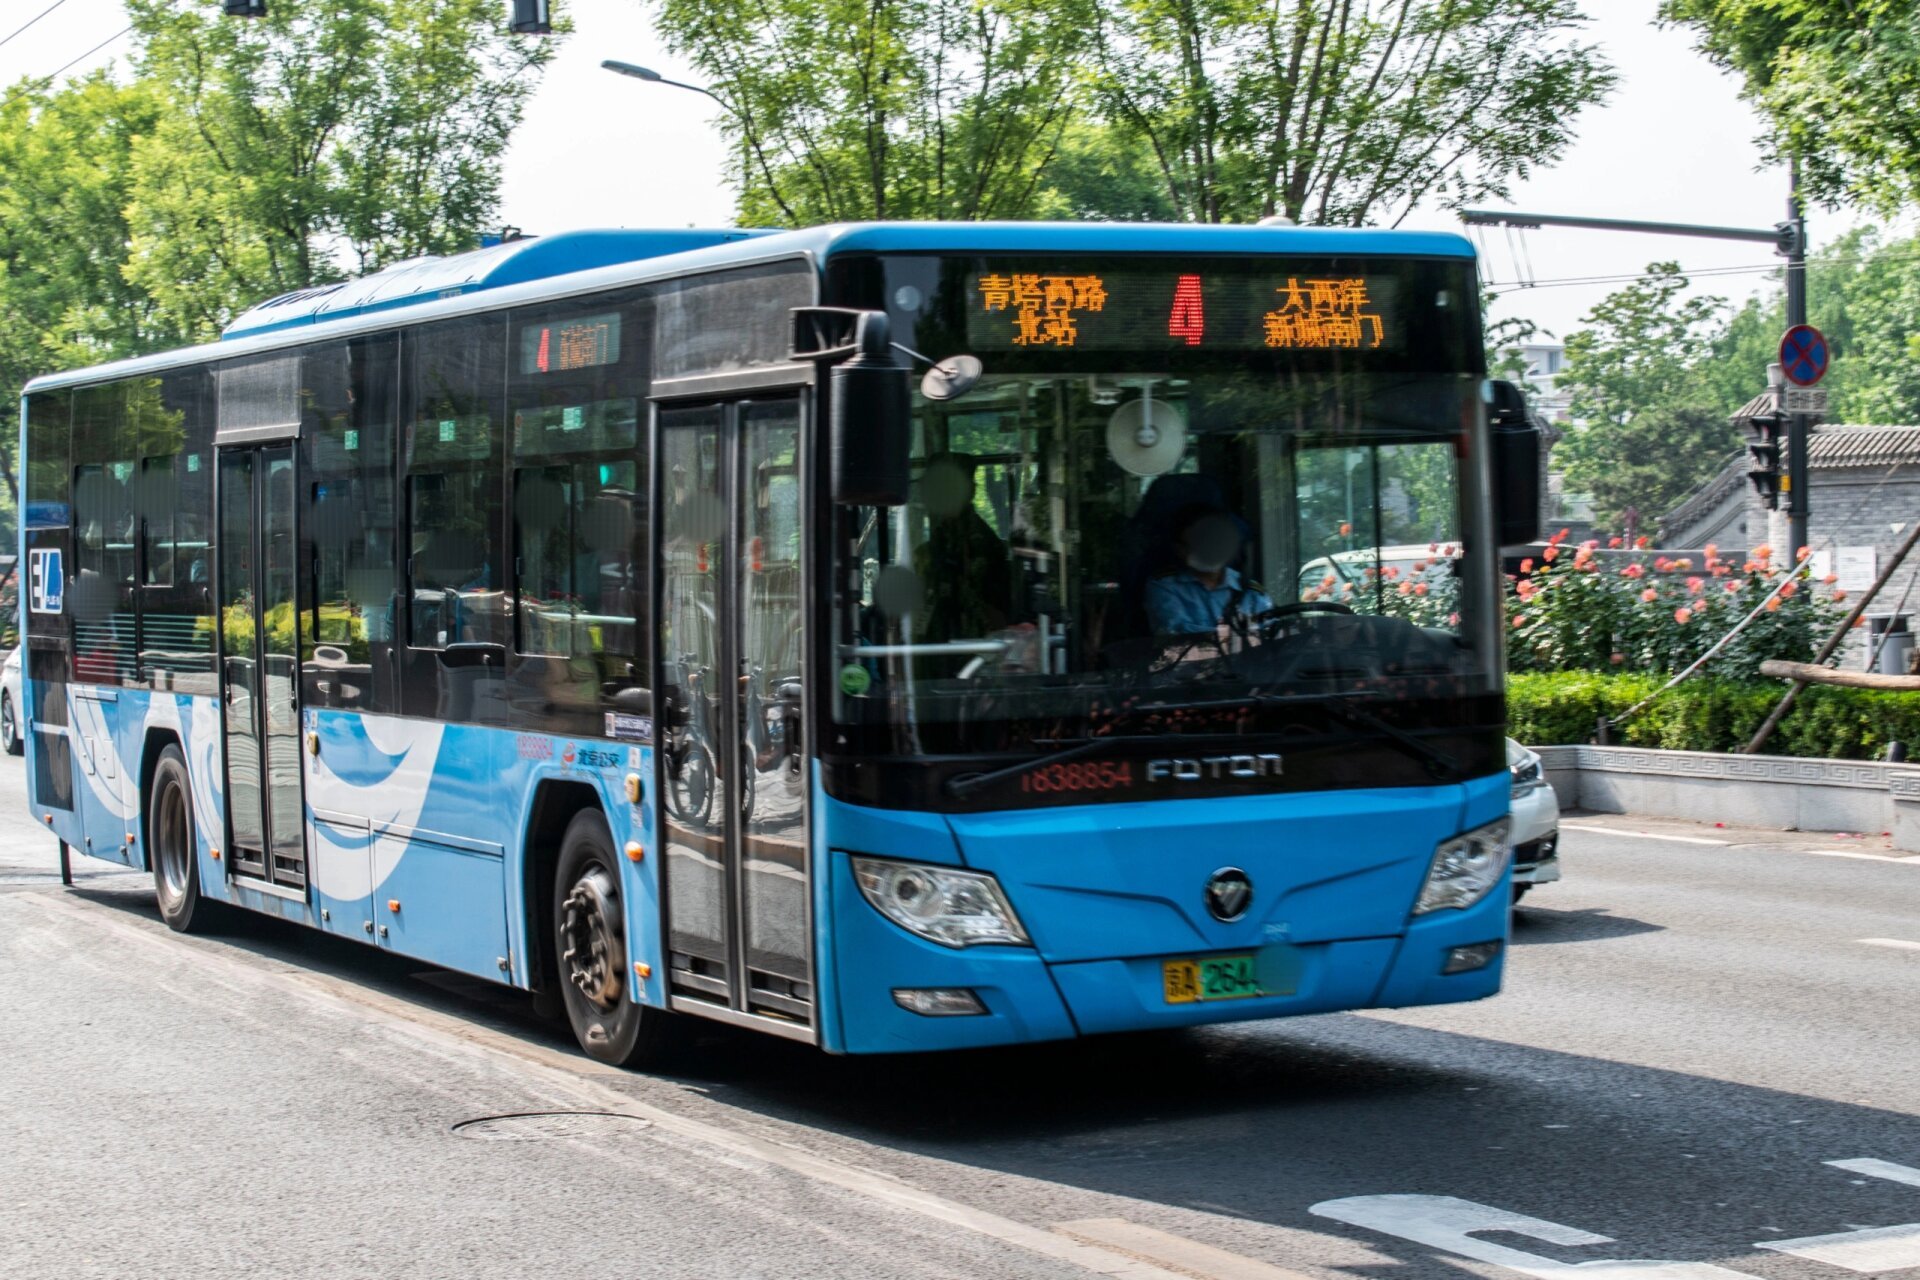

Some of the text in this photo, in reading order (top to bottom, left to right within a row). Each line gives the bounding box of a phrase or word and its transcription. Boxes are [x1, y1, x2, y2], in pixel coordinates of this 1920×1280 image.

[1169, 275, 1203, 345] 4
[1276, 278, 1370, 313] 大西洋
[1263, 311, 1384, 347] 新城南门
[1146, 754, 1283, 782] FOTON
